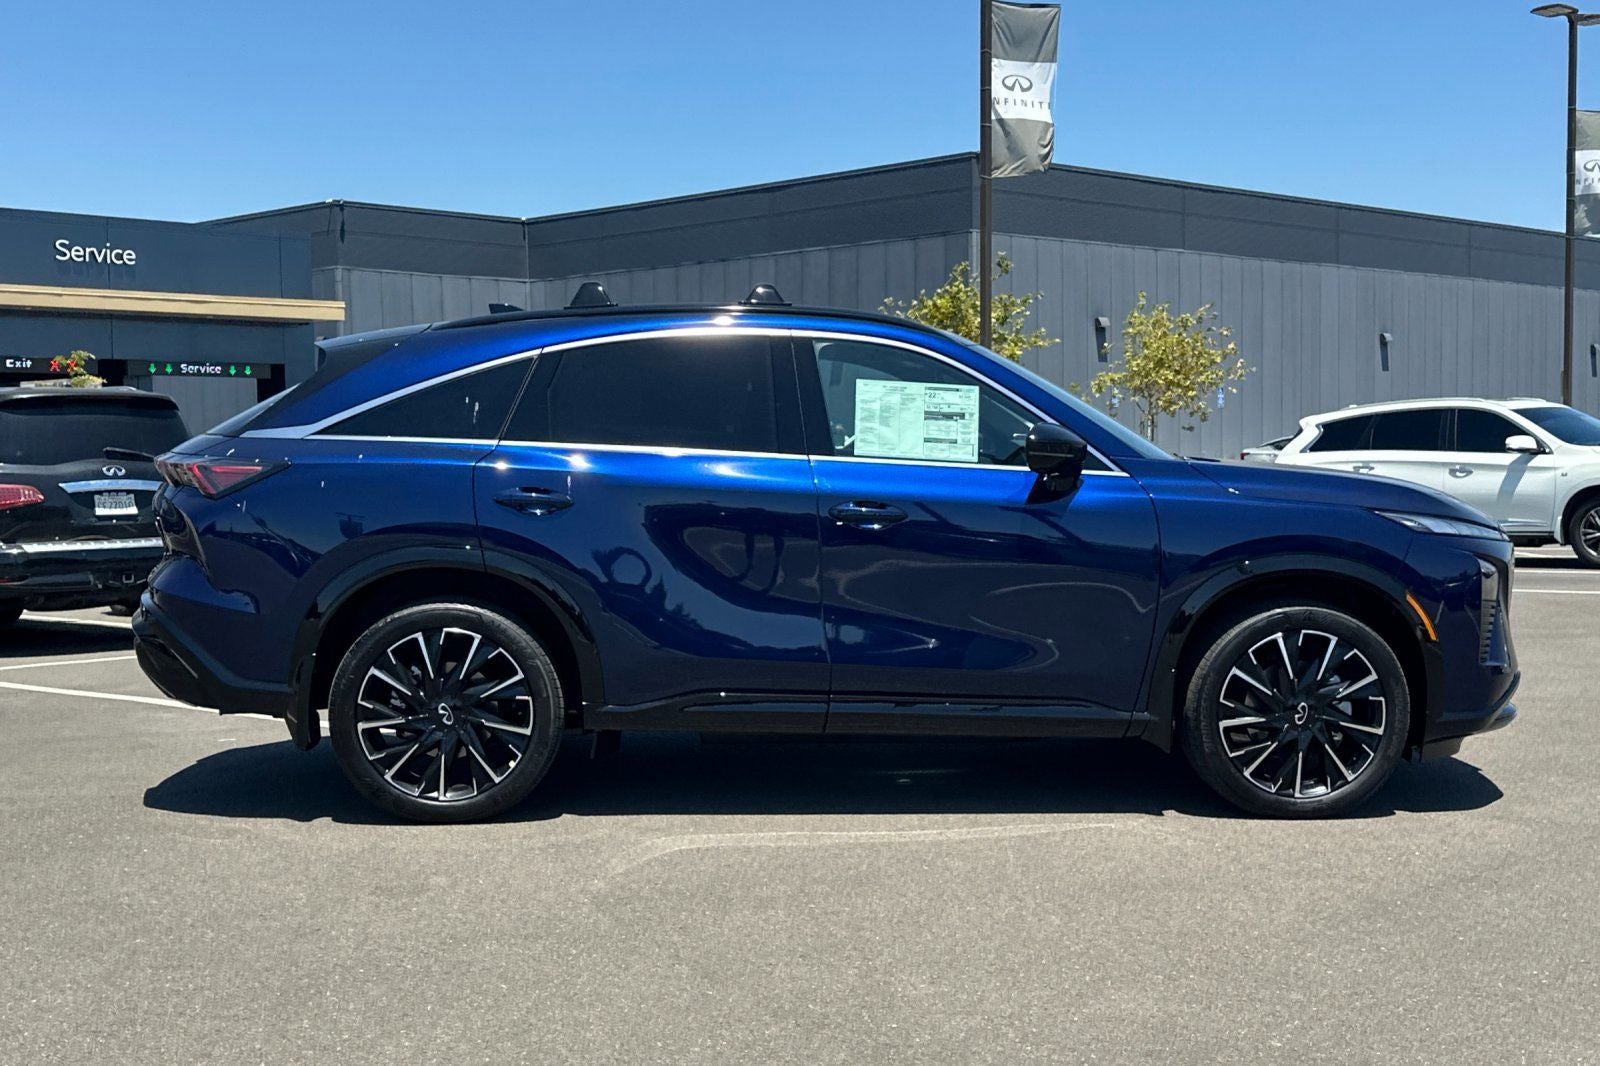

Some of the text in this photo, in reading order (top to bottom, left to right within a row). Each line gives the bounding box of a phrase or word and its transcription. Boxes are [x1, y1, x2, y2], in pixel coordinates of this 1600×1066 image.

[992, 97, 1051, 110] NFINITI
[55, 239, 137, 265] Service
[5, 358, 33, 368] Exit
[180, 363, 222, 374] Service
